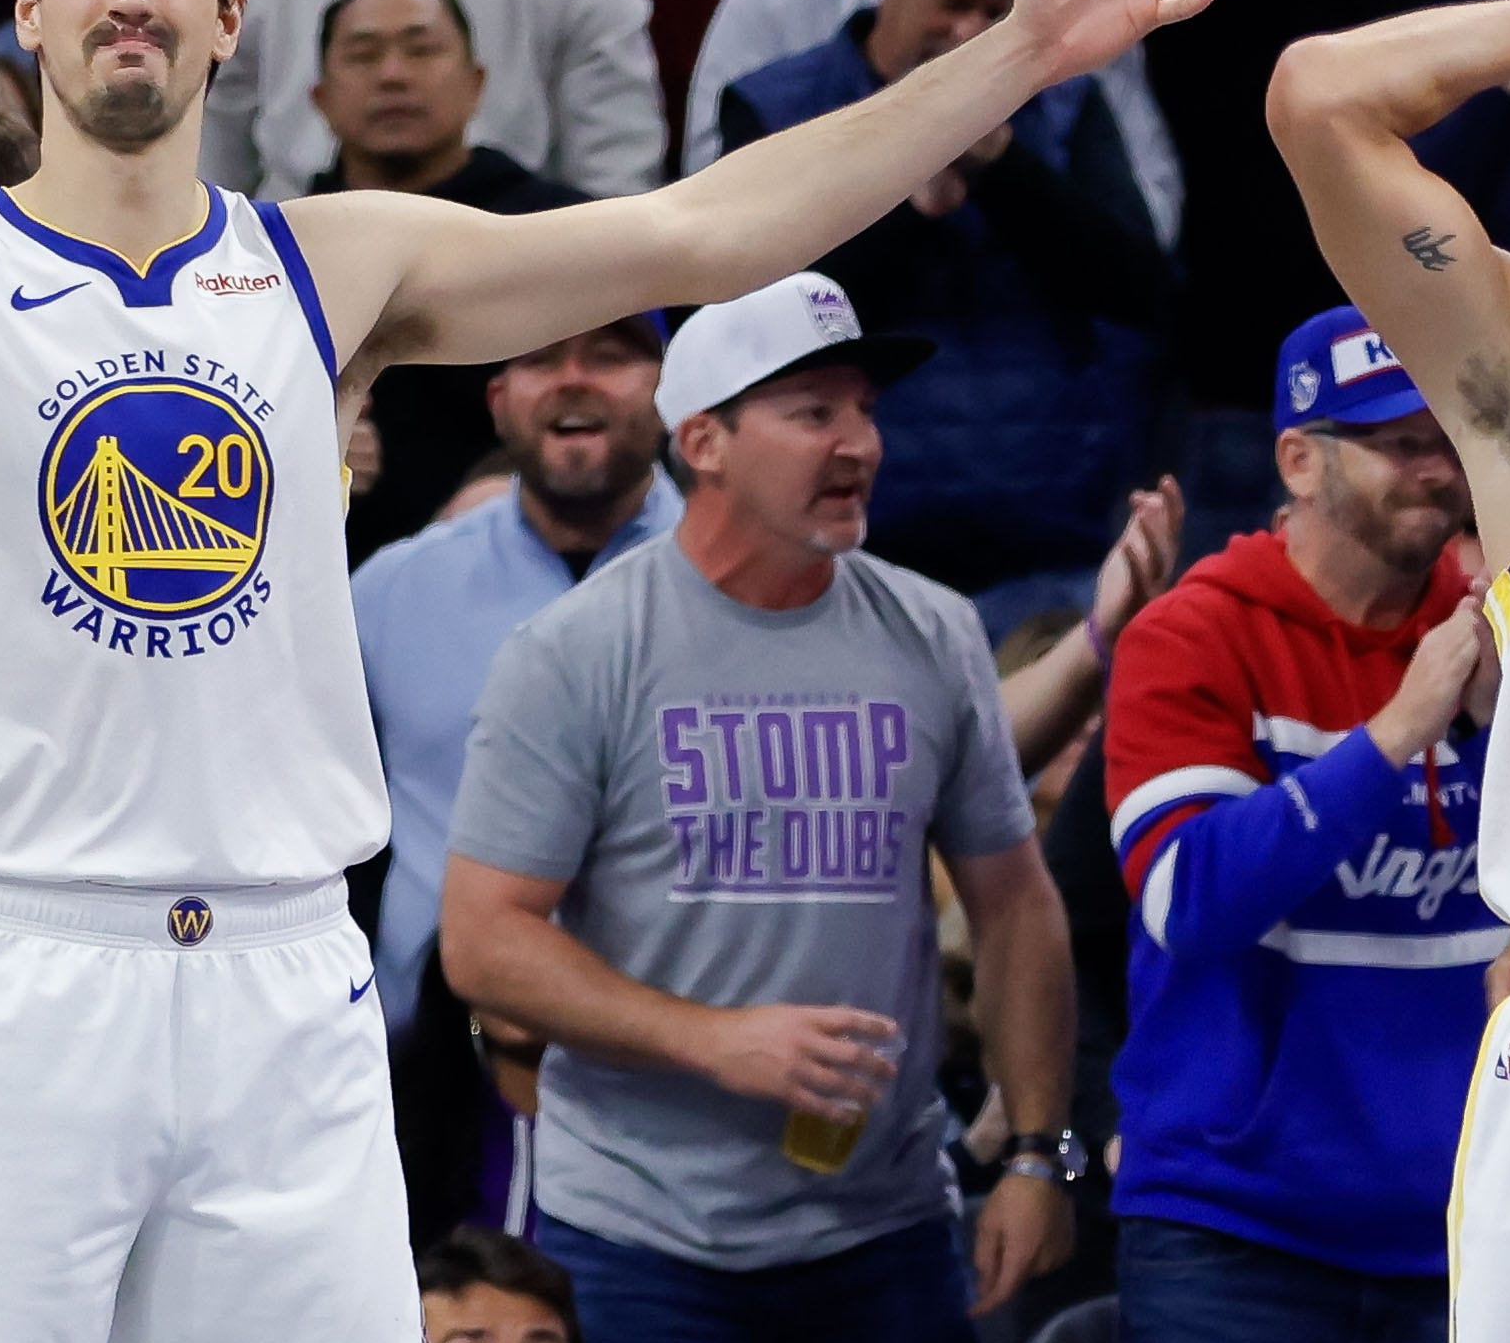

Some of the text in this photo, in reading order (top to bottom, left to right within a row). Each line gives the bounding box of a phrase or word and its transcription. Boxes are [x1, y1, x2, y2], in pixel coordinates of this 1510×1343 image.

[195, 272, 281, 294] Rakuten
[37, 349, 275, 423] GOLDEN STATE
[177, 433, 253, 499] 20
[39, 568, 272, 659] WARRIORS
[658, 700, 911, 806] STOMP
[668, 810, 907, 879] THE DUBS
[171, 909, 211, 939] W
